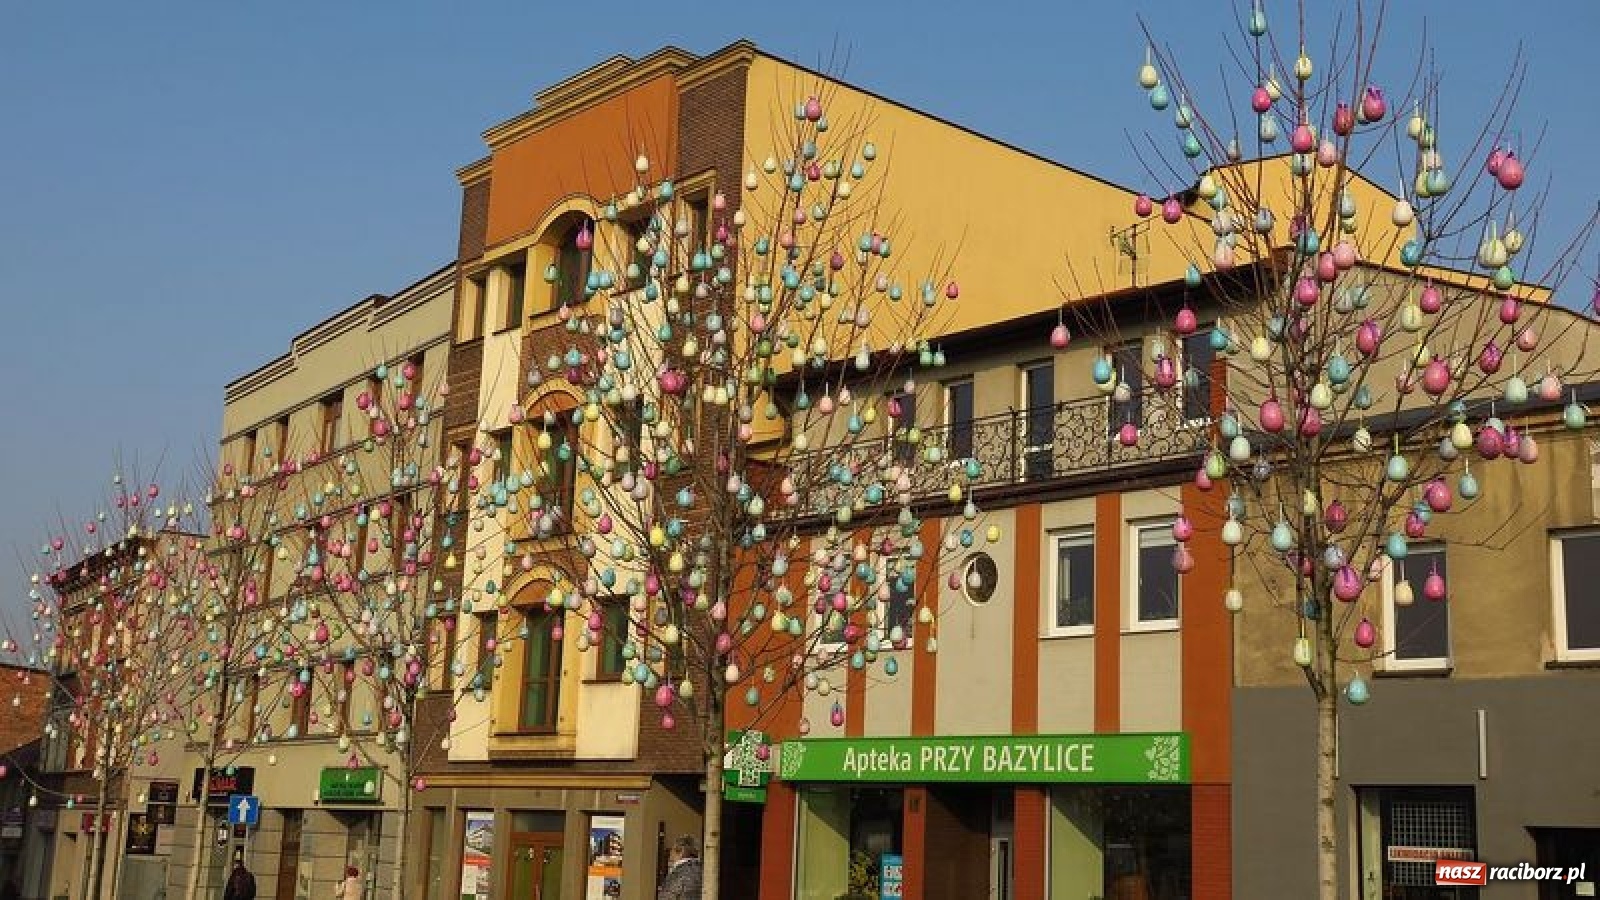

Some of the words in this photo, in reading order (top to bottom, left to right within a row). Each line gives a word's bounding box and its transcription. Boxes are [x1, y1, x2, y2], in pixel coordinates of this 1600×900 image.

[843, 745, 911, 778] Apteka
[920, 745, 975, 772] PRZY
[983, 743, 1095, 773] BAZYLICE
